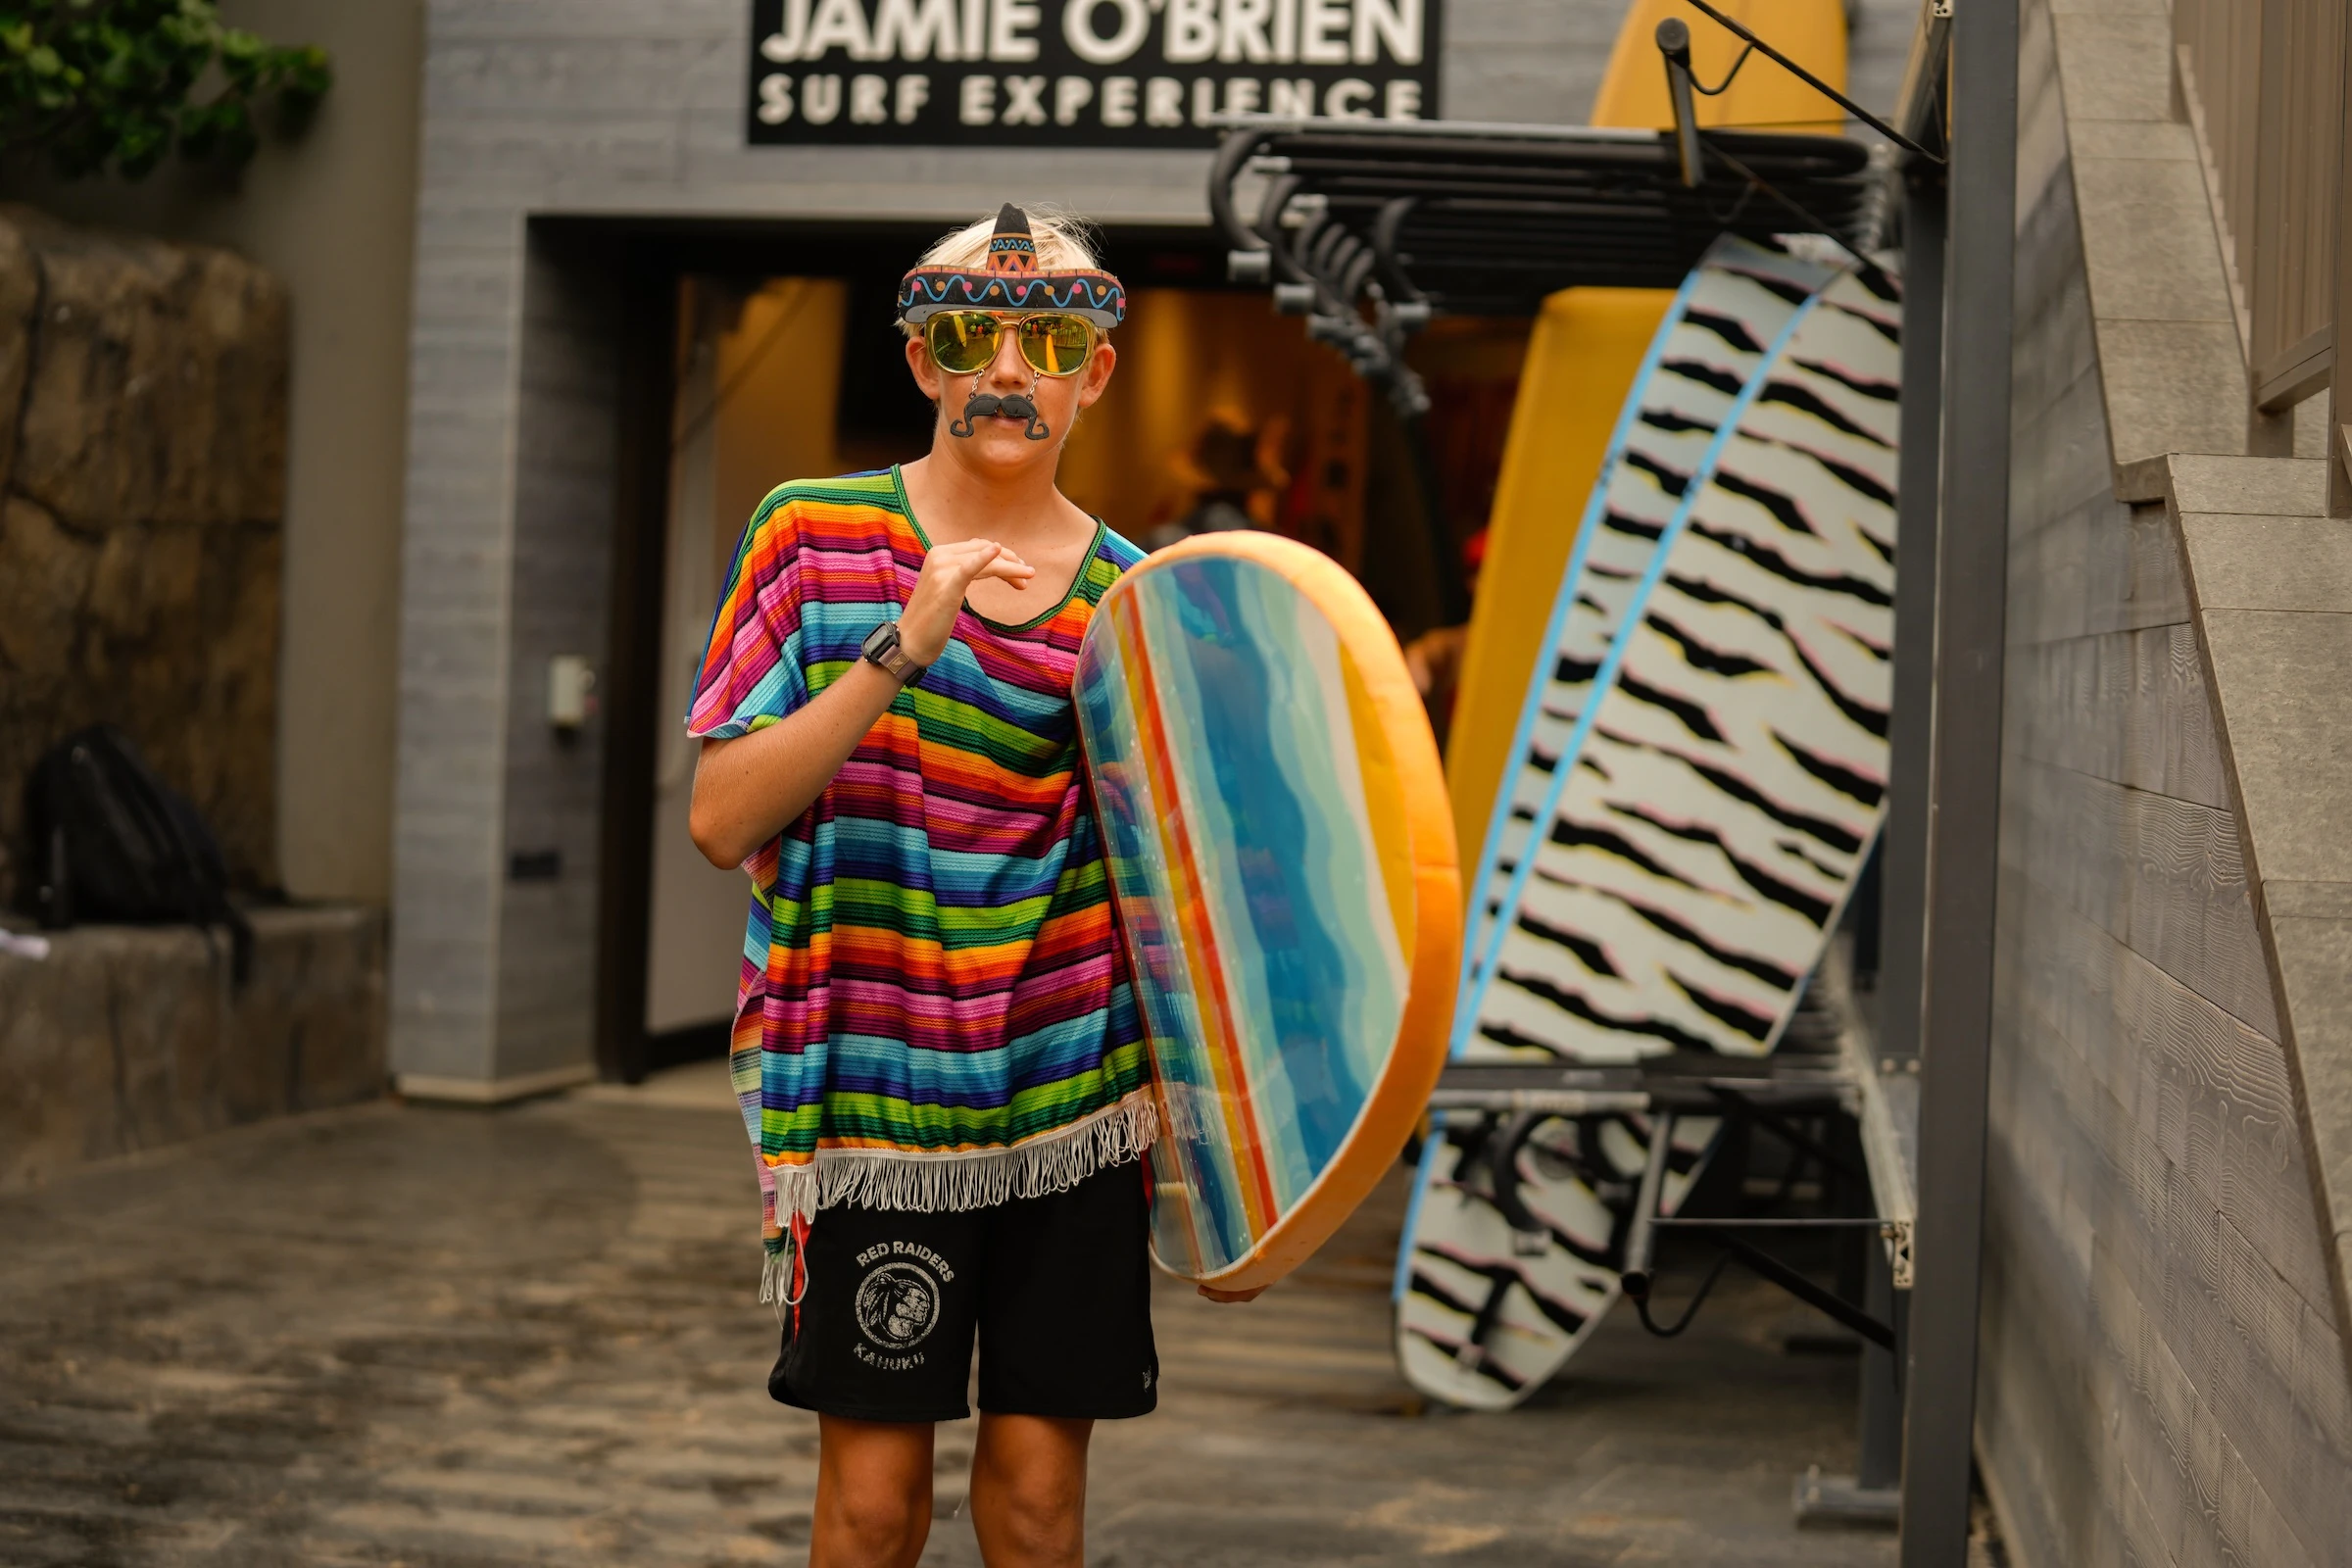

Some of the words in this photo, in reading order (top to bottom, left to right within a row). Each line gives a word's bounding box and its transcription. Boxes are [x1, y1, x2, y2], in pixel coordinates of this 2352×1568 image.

[760, 0, 1042, 63] JAMIE
[758, 73, 930, 124] SURF
[958, 75, 1423, 126] EXPERIENCE
[856, 1243, 890, 1267] RED
[892, 1241, 956, 1283] RAIDERS
[853, 1342, 925, 1370] KAHUKU
